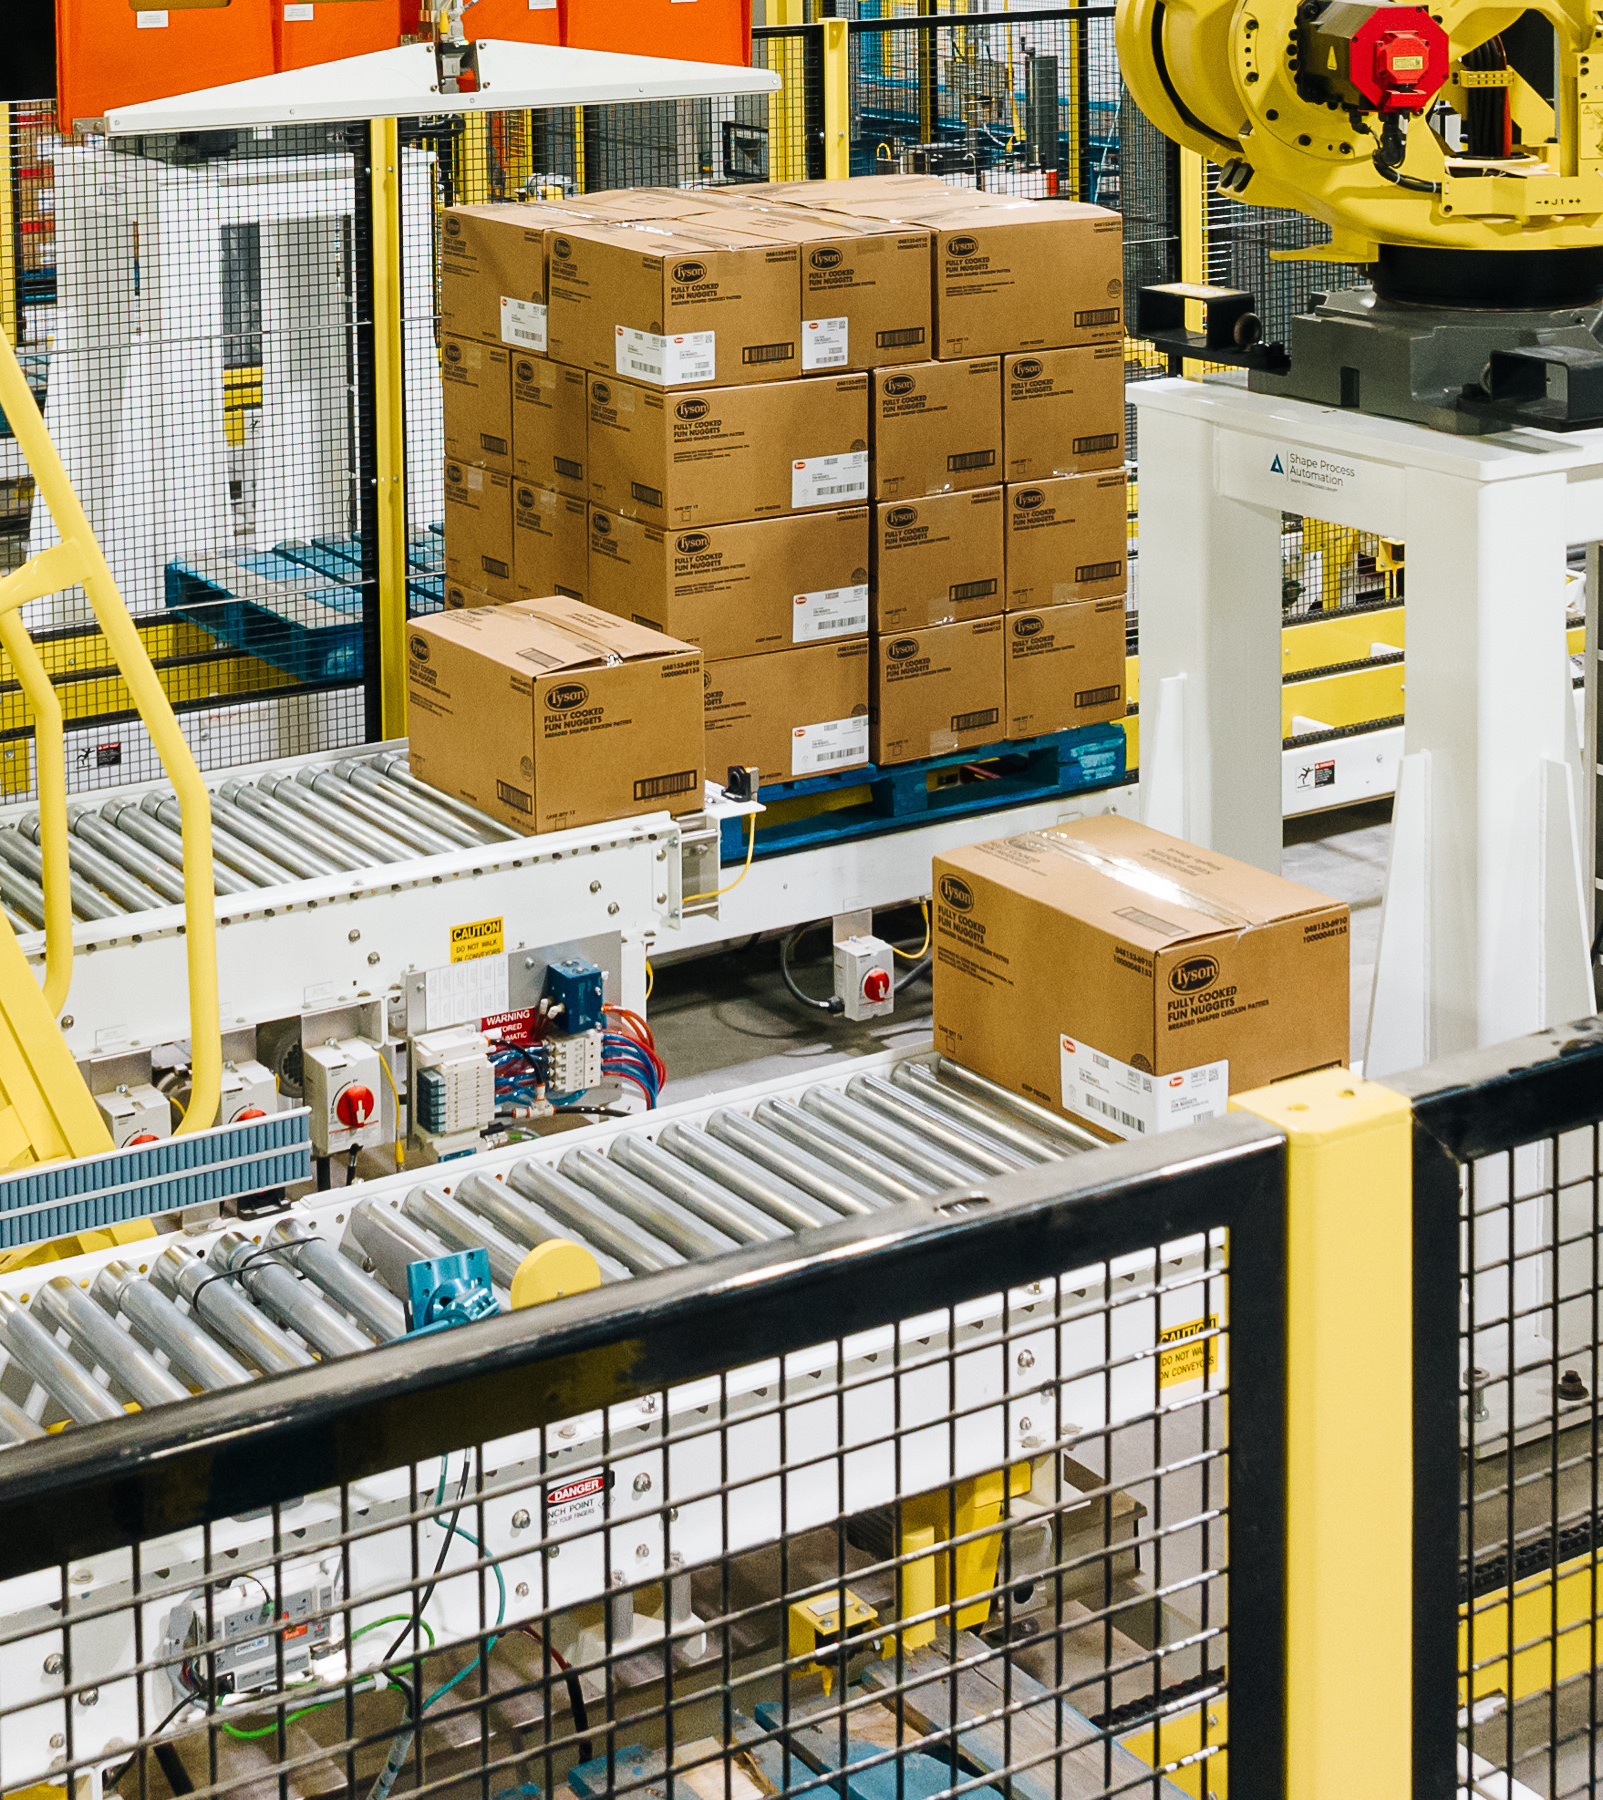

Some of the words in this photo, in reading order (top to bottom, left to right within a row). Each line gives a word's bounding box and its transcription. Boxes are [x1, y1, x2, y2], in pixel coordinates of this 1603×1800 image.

[814, 253, 839, 266] Tyson
[678, 265, 705, 280] Tyson
[679, 403, 707, 417] Tyson
[674, 422, 693, 431] FULLY
[694, 420, 722, 428] COOKED
[689, 427, 720, 436] NUGGETS
[1289, 453, 1318, 468] Shape
[1320, 459, 1355, 477] Process
[1290, 465, 1343, 486] Automation
[680, 537, 708, 549] Tyson
[675, 557, 693, 565] FULLY
[695, 553, 723, 562] COOKED
[675, 564, 689, 572] FUN
[690, 560, 721, 569] NUGGETS
[551, 690, 585, 707] Tyson
[544, 713, 568, 723] FULLY
[570, 707, 604, 719] COOKED
[544, 723, 561, 732] FUN
[564, 716, 602, 729] NUGGETS
[944, 879, 972, 904] Tyson
[938, 905, 956, 921] FULLY
[958, 913, 986, 934] COOKED
[1304, 917, 1347, 934] 048153-6910
[453, 921, 501, 941] CAUTION
[938, 915, 952, 929] FUN
[953, 921, 984, 944] NUGGETS
[1303, 926, 1347, 943] 10000048153
[467, 942, 479, 951] NOT
[481, 939, 498, 948] WALK
[1176, 965, 1217, 989] Tyson
[1168, 996, 1195, 1011] FULLY
[1198, 985, 1237, 1004] COOKED
[486, 1009, 530, 1026] WARNING
[1168, 1009, 1188, 1022] FUN
[1190, 997, 1235, 1018] NUGGETS
[1168, 1018, 1195, 1031] BREADED
[1197, 1012, 1219, 1024] SHAPED
[1221, 1005, 1246, 1018] CHICKEN
[1248, 999, 1269, 1010] PATTIES
[501, 1022, 523, 1033] TORED
[1162, 1356, 1173, 1366] DO
[1175, 1350, 1189, 1362] NOT
[1172, 1356, 1214, 1377] CONVEYOS
[554, 1479, 599, 1501] DANGER
[547, 1508, 566, 1519] NCH
[570, 1498, 594, 1512] POINT
